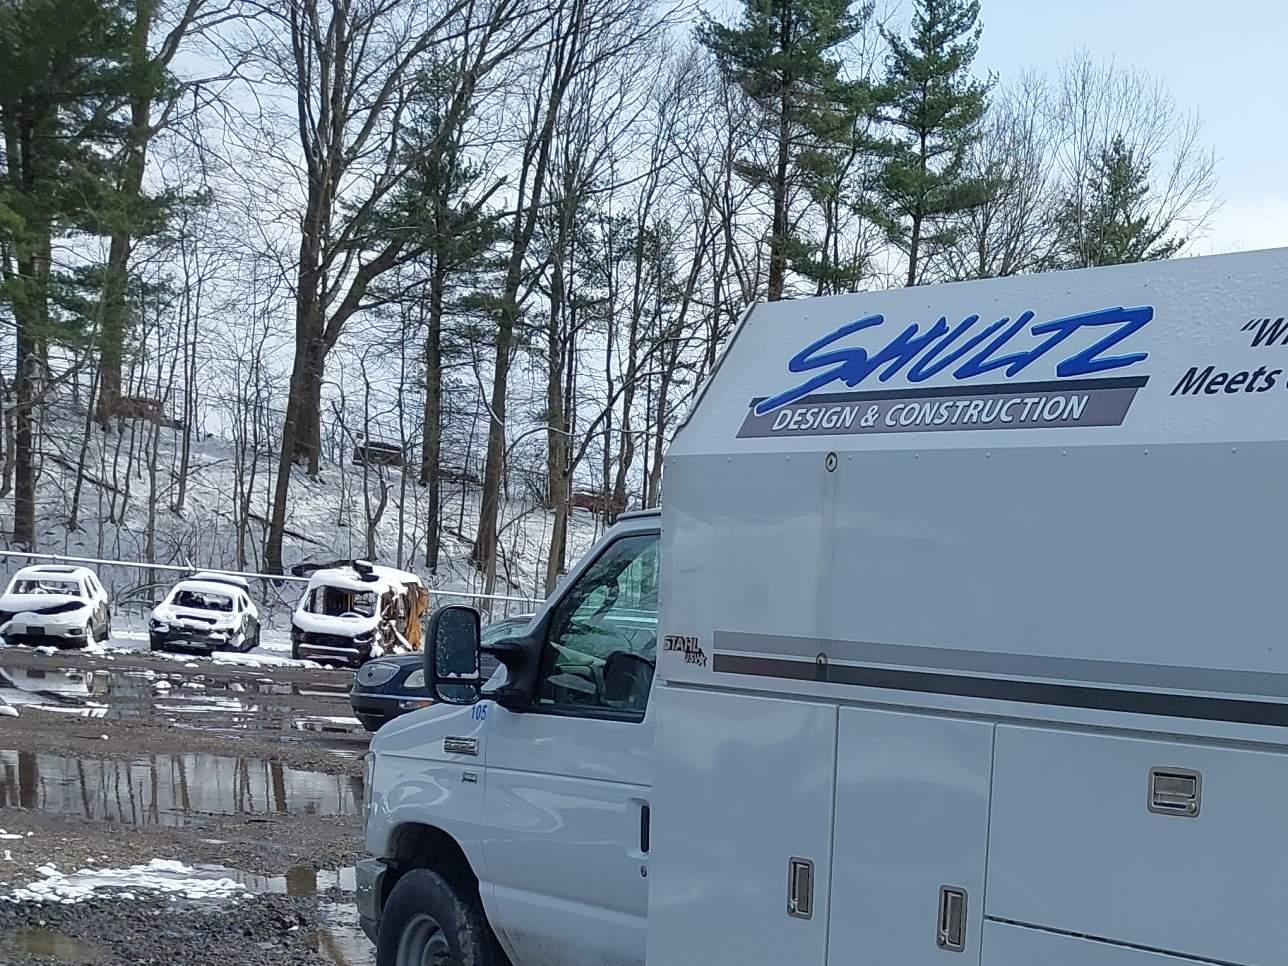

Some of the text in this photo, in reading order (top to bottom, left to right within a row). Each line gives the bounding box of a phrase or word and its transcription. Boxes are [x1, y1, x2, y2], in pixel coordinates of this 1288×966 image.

[754, 305, 1154, 416] SHULTZ
[1169, 365, 1282, 397] Meets
[771, 395, 1091, 432] DESIGN & CONSTRUCTION
[664, 635, 700, 652] STAHL
[470, 703, 488, 722] 105
